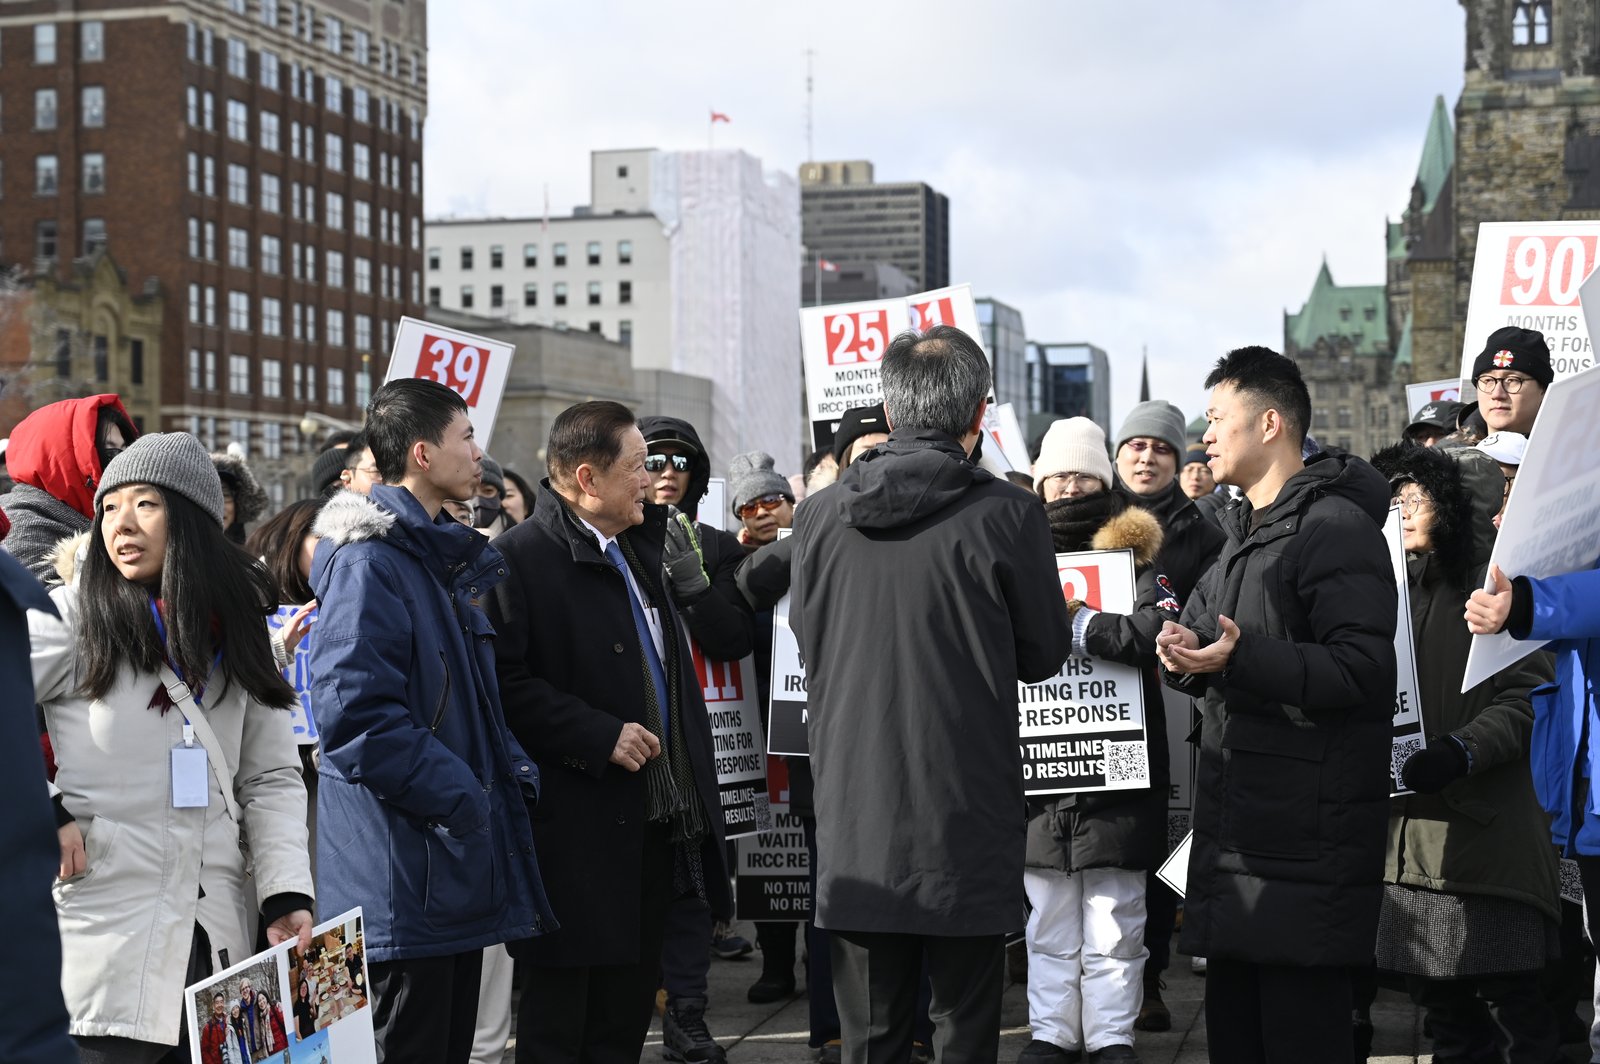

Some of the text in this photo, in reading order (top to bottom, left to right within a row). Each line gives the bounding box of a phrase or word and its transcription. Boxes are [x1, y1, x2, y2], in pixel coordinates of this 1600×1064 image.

[1511, 236, 1585, 305] 90
[1507, 315, 1577, 331] MONTHS
[830, 312, 884, 364] 25
[421, 339, 480, 401] 39
[835, 369, 881, 382] MONTH
[823, 383, 874, 398] WAITING
[818, 400, 843, 413] IRCC
[1018, 680, 1117, 703] ITING FOR
[1026, 703, 1130, 726] RESPONSE
[714, 732, 753, 752] TING FOR
[716, 754, 760, 775] RESPONSE
[1036, 759, 1105, 779] RESULTS
[720, 787, 755, 805] TIMELINES
[725, 806, 755, 824] RESULTS
[758, 833, 808, 848] WAITI
[747, 853, 784, 868] IRCC
[764, 882, 783, 894] NO
[770, 898, 788, 910] NO
